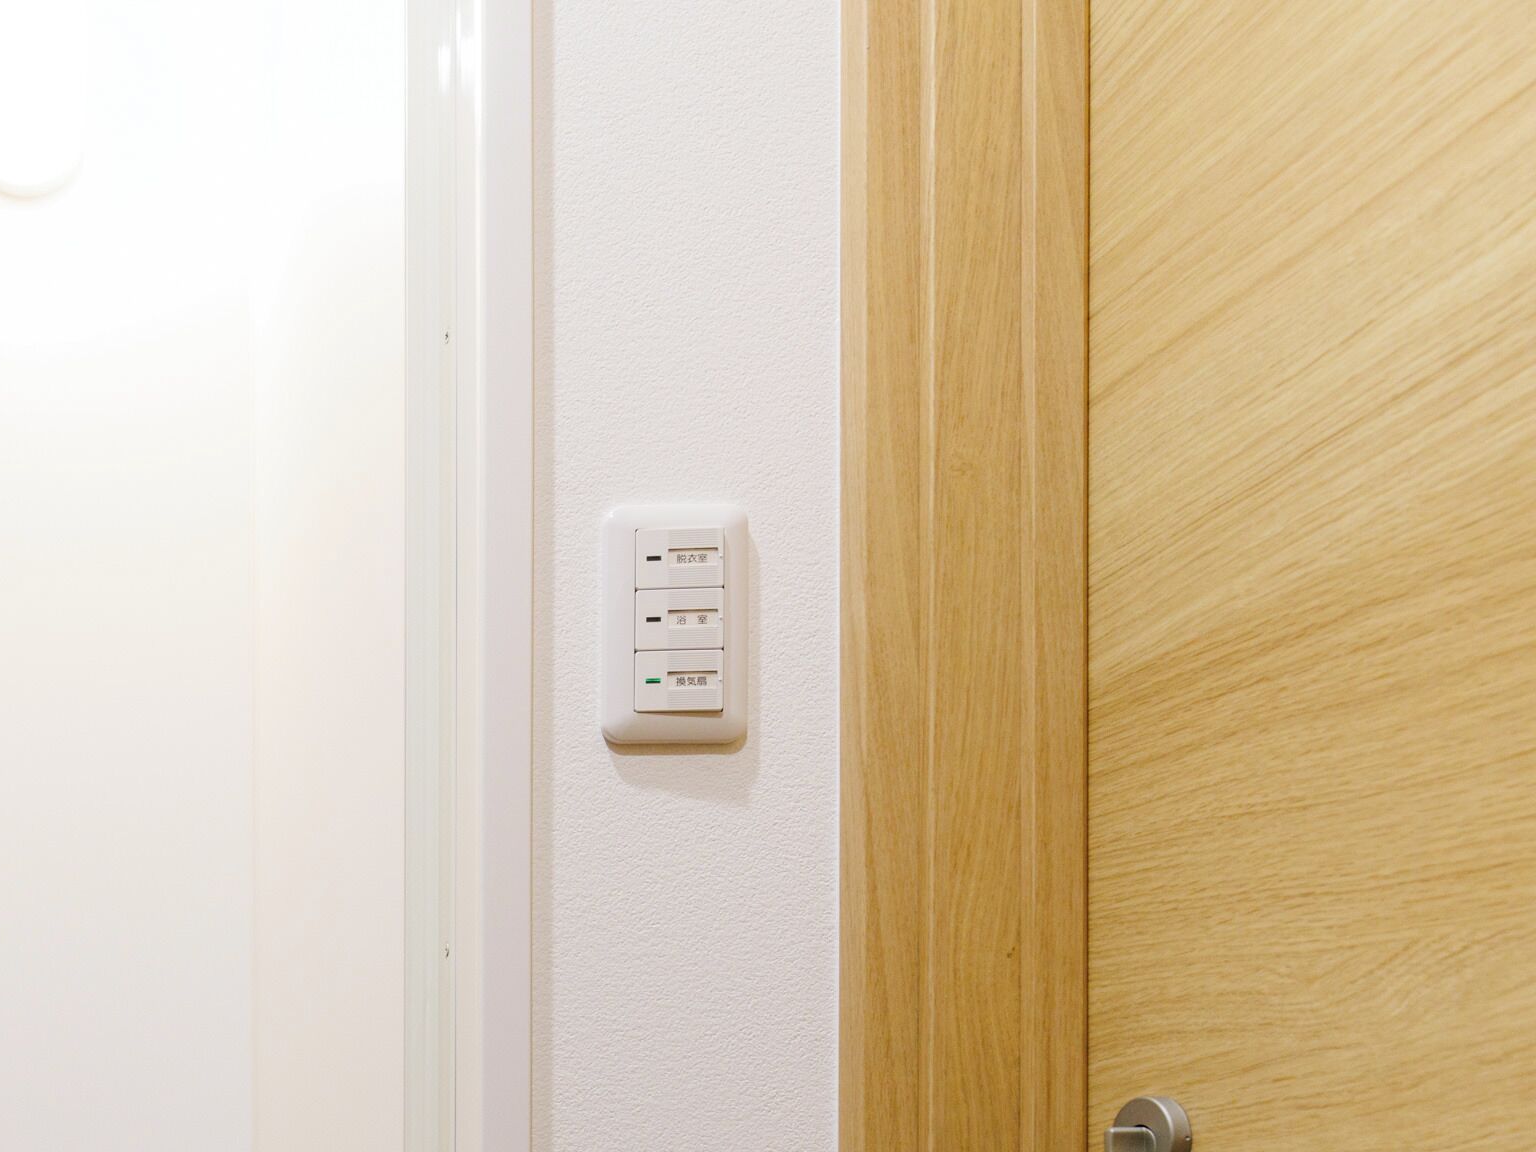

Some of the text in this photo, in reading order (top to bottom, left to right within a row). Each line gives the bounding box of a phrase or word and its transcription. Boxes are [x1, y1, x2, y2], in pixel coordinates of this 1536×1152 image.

[676, 553, 708, 564] 脱衣室
[675, 676, 707, 687] 換気扇
